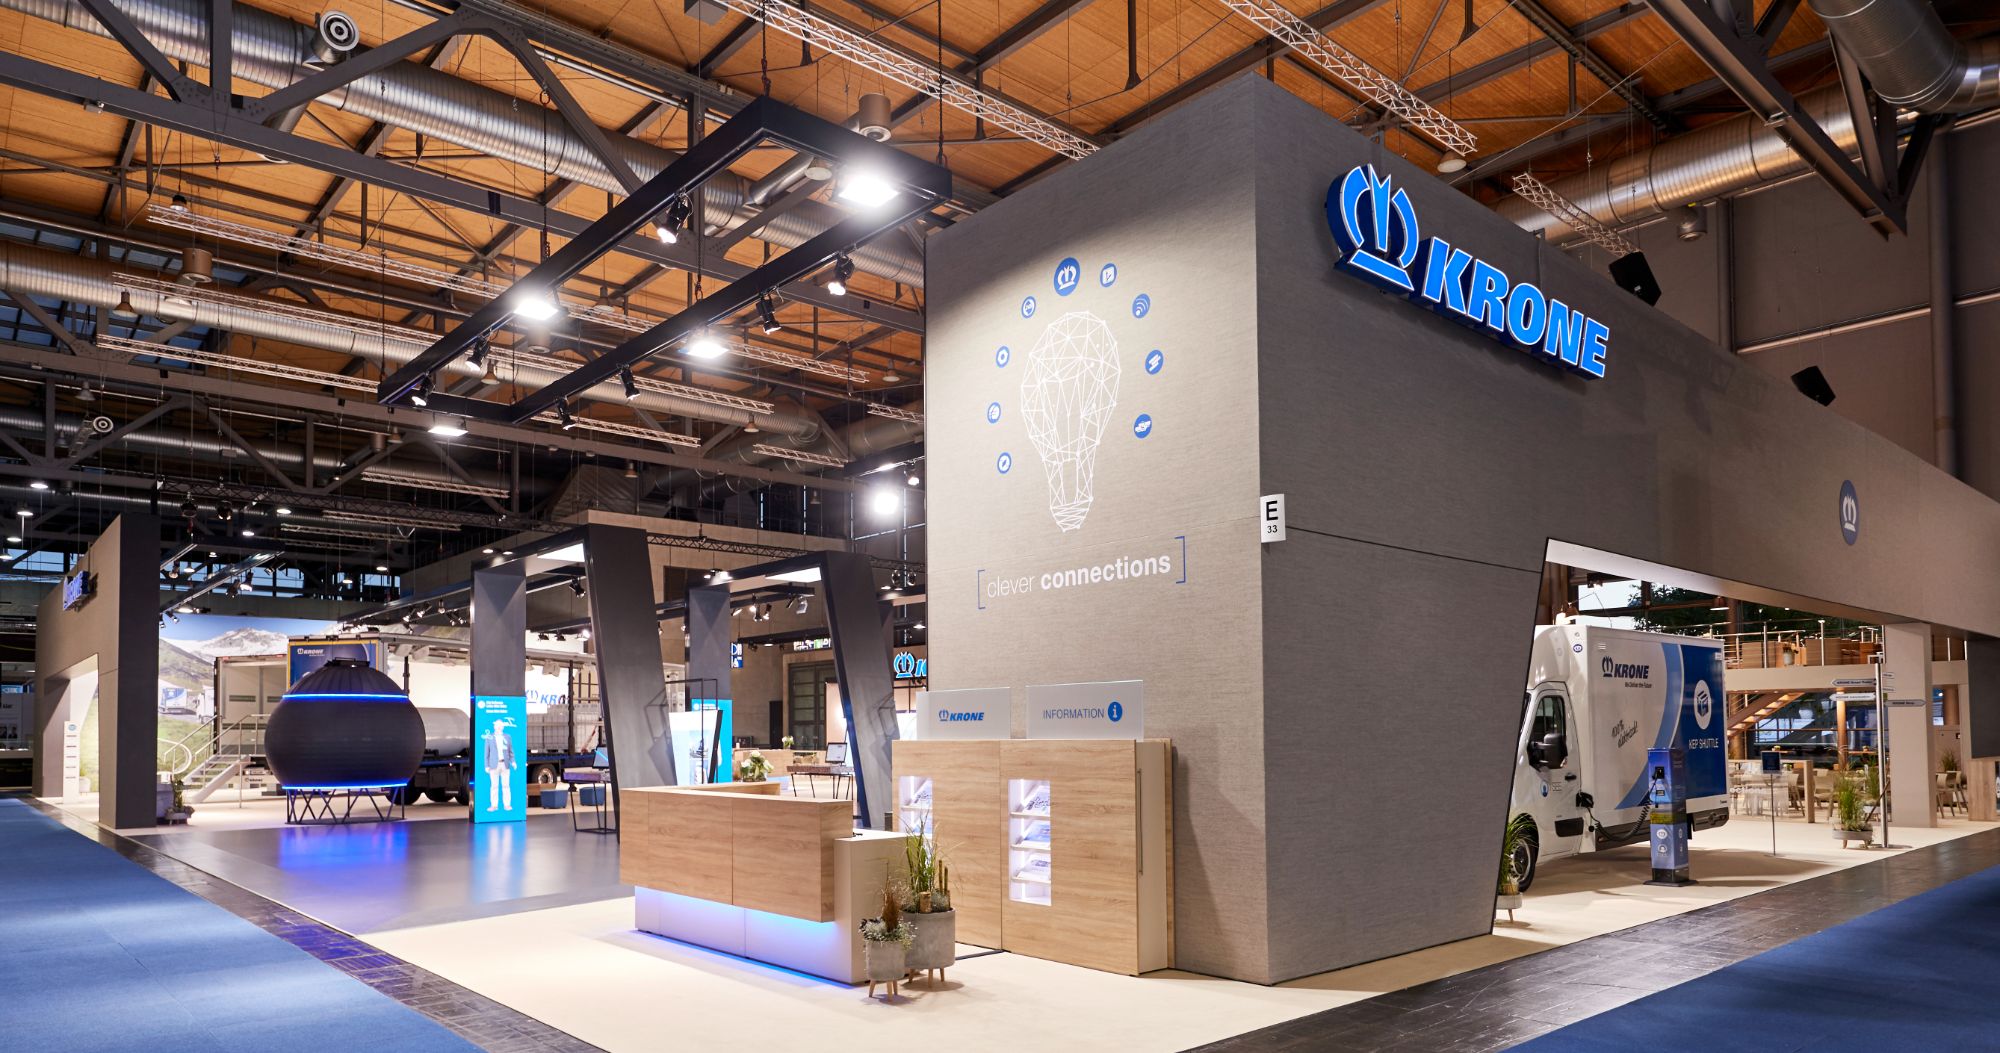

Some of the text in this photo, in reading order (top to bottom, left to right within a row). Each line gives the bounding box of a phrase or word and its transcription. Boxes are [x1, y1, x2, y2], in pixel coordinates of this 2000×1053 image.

[1422, 236, 1610, 378] KRONE
[1266, 500, 1279, 521] E
[1267, 524, 1278, 534] 33
[987, 555, 1172, 598] clever connections
[1614, 664, 1649, 679] KRONE
[949, 711, 985, 722] KRONE
[1042, 708, 1105, 720] INFORMATION
[1699, 738, 1719, 749] SHUTTLE
